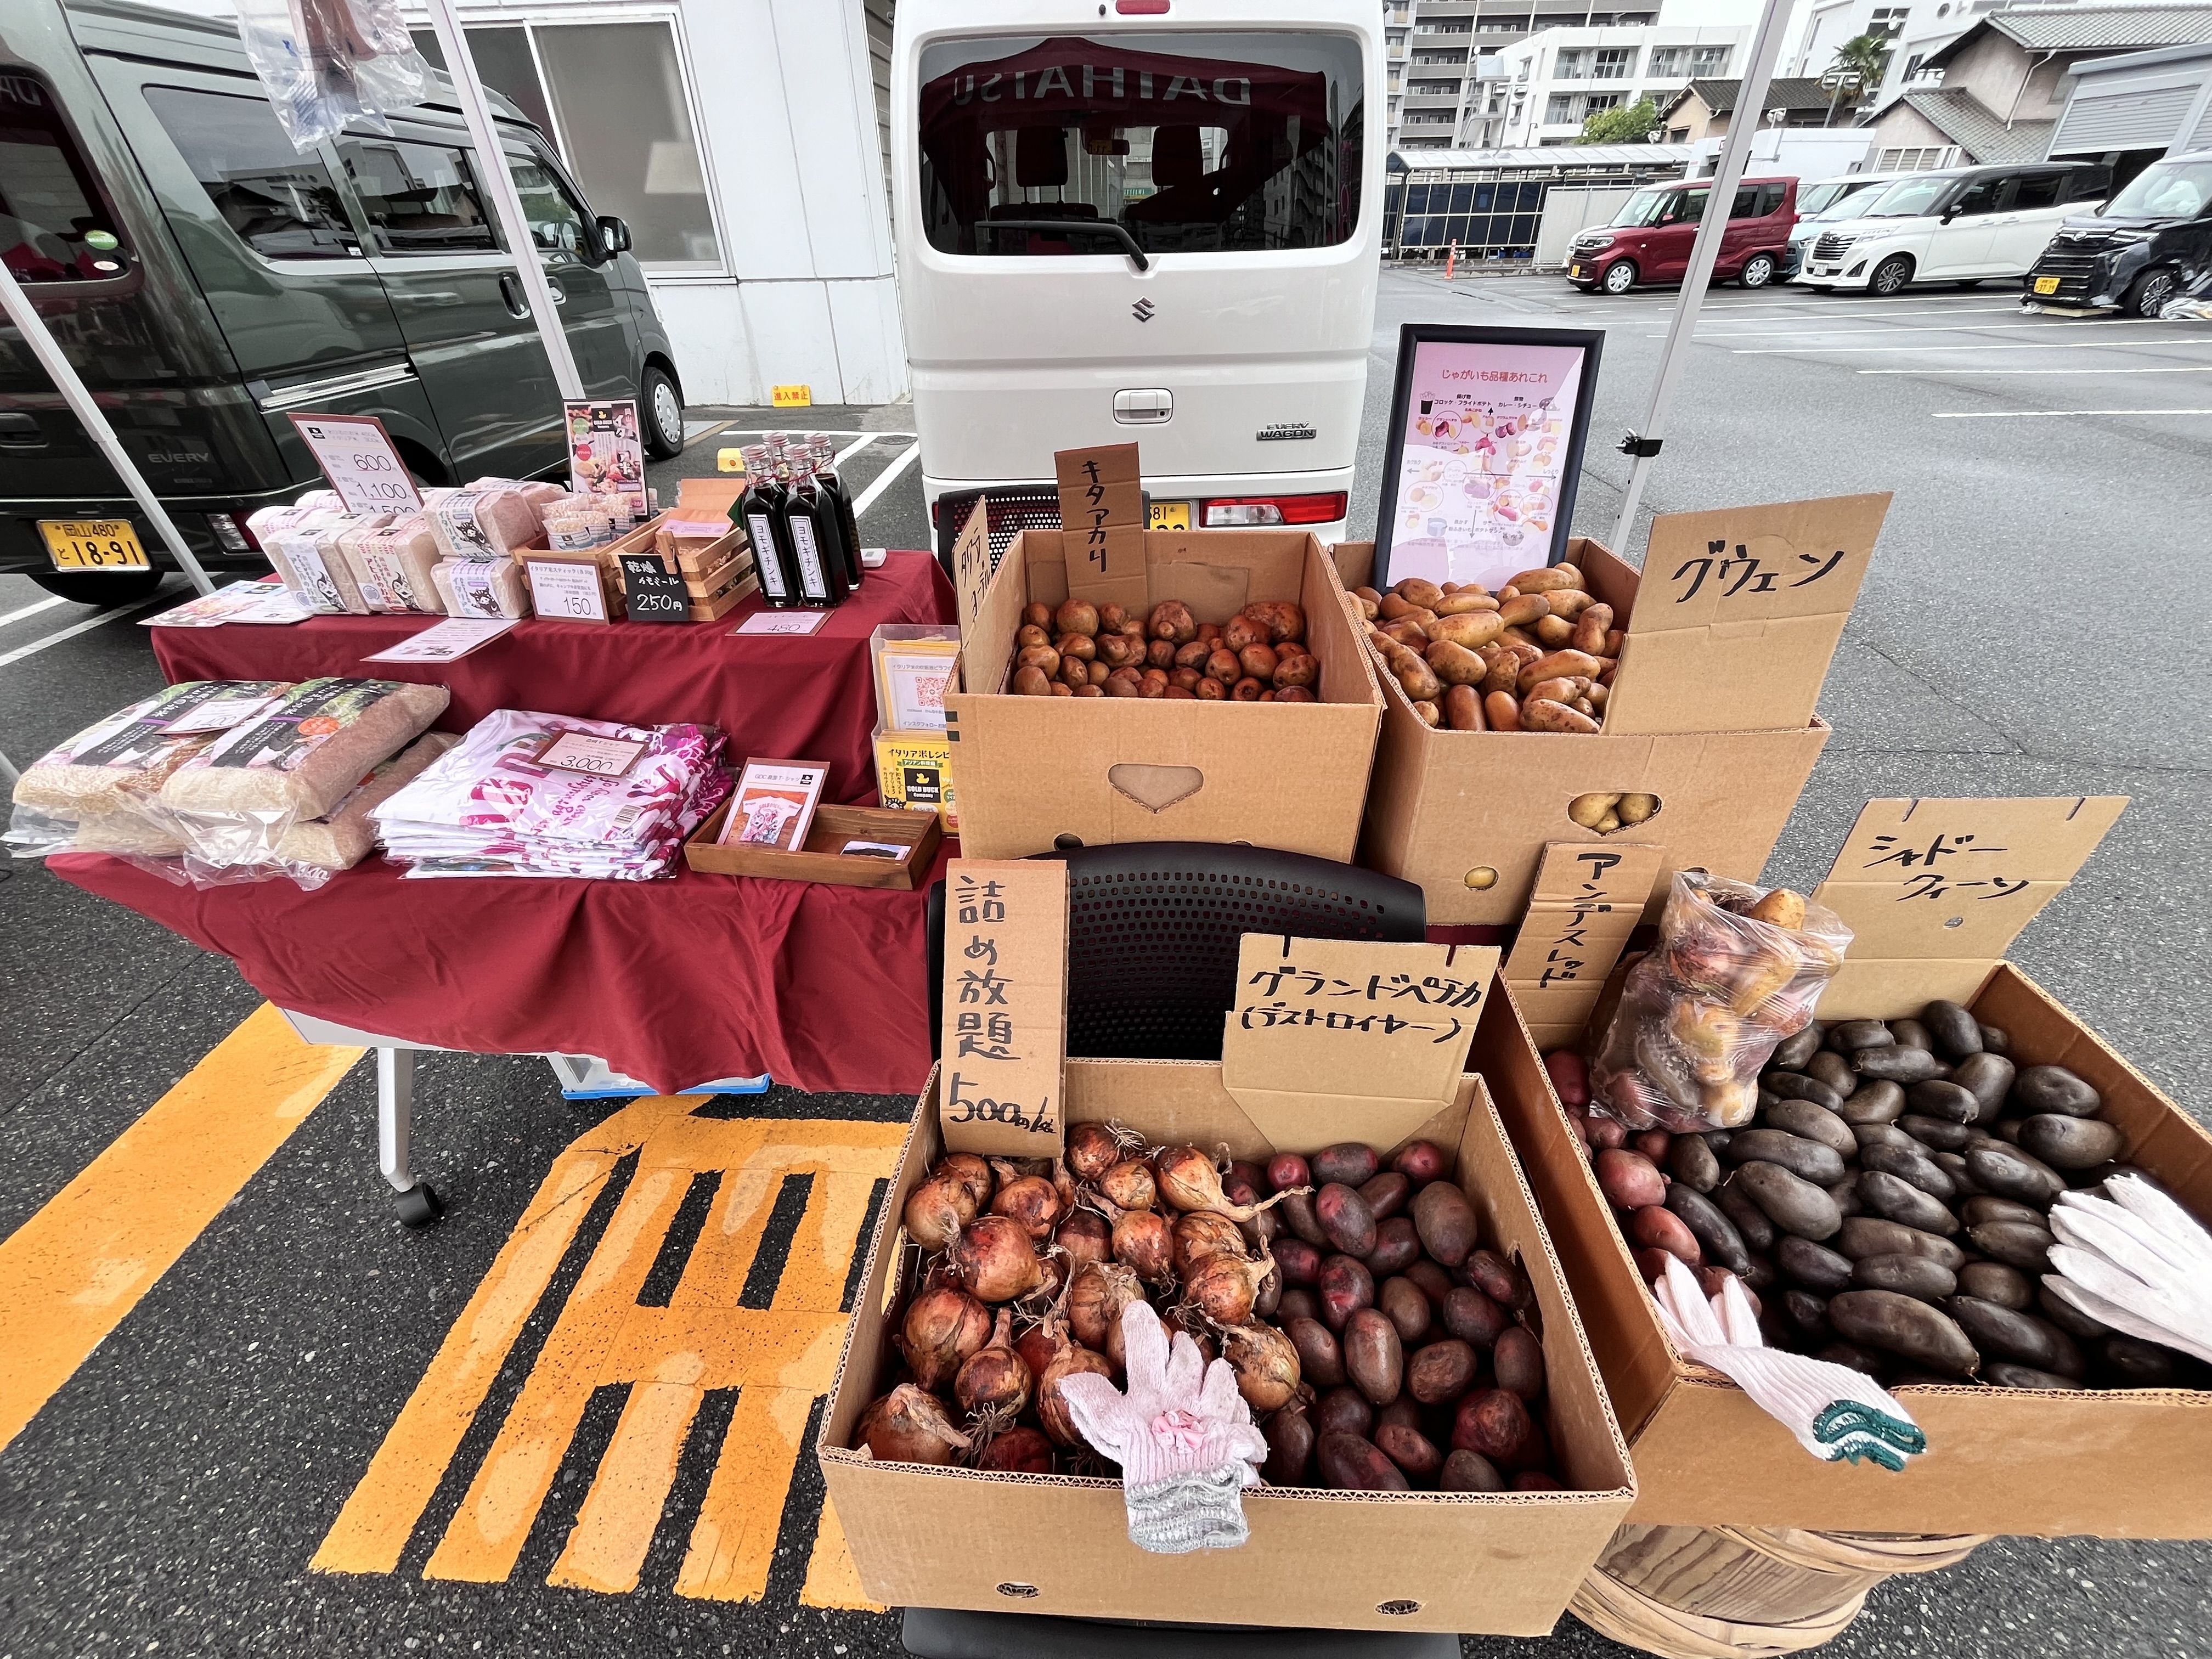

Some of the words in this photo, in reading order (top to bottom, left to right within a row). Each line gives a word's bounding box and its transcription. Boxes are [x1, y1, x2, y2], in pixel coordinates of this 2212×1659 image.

[1442, 369, 1548, 383] じゃがいも品種あれこれ
[774, 391, 808, 400] 進入禁止
[1261, 430, 1313, 438] WAGON
[1267, 421, 1310, 430] EVERY
[148, 453, 209, 463] EVERY
[353, 454, 392, 471] 600
[356, 482, 407, 499] 1,100
[1081, 460, 1109, 573] キタアカリ
[57, 548, 70, 560] と
[71, 540, 141, 566] 18-91
[756, 526, 778, 585] ヨモギチンキ
[798, 526, 817, 587] ヨモギチンキ
[1671, 540, 1844, 603] グウェン
[639, 576, 679, 586] カモミール
[563, 597, 591, 616] 150
[636, 594, 682, 612] 250円
[561, 755, 613, 771] 3,000
[1863, 834, 2008, 868] シャドー
[1540, 853, 1622, 988] アンデスレッド
[955, 876, 1021, 1060] 詰め放題
[1249, 966, 1482, 1008] グランドペチカ
